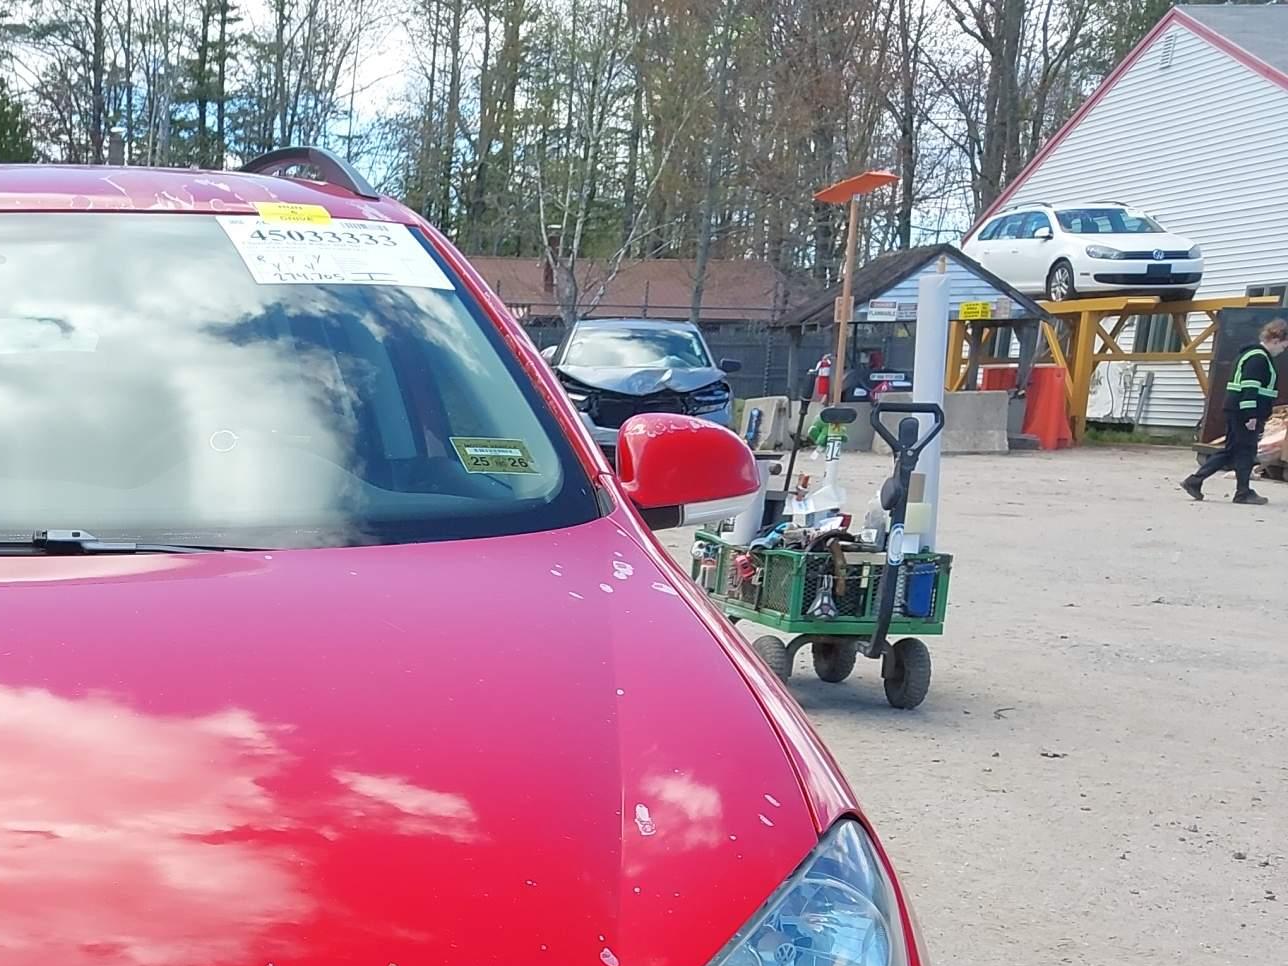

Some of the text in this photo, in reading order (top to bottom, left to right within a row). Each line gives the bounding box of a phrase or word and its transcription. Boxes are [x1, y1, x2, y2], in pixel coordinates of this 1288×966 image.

[250, 230, 397, 247] 45033333
[470, 456, 490, 467] 25
[508, 457, 529, 468] 26
